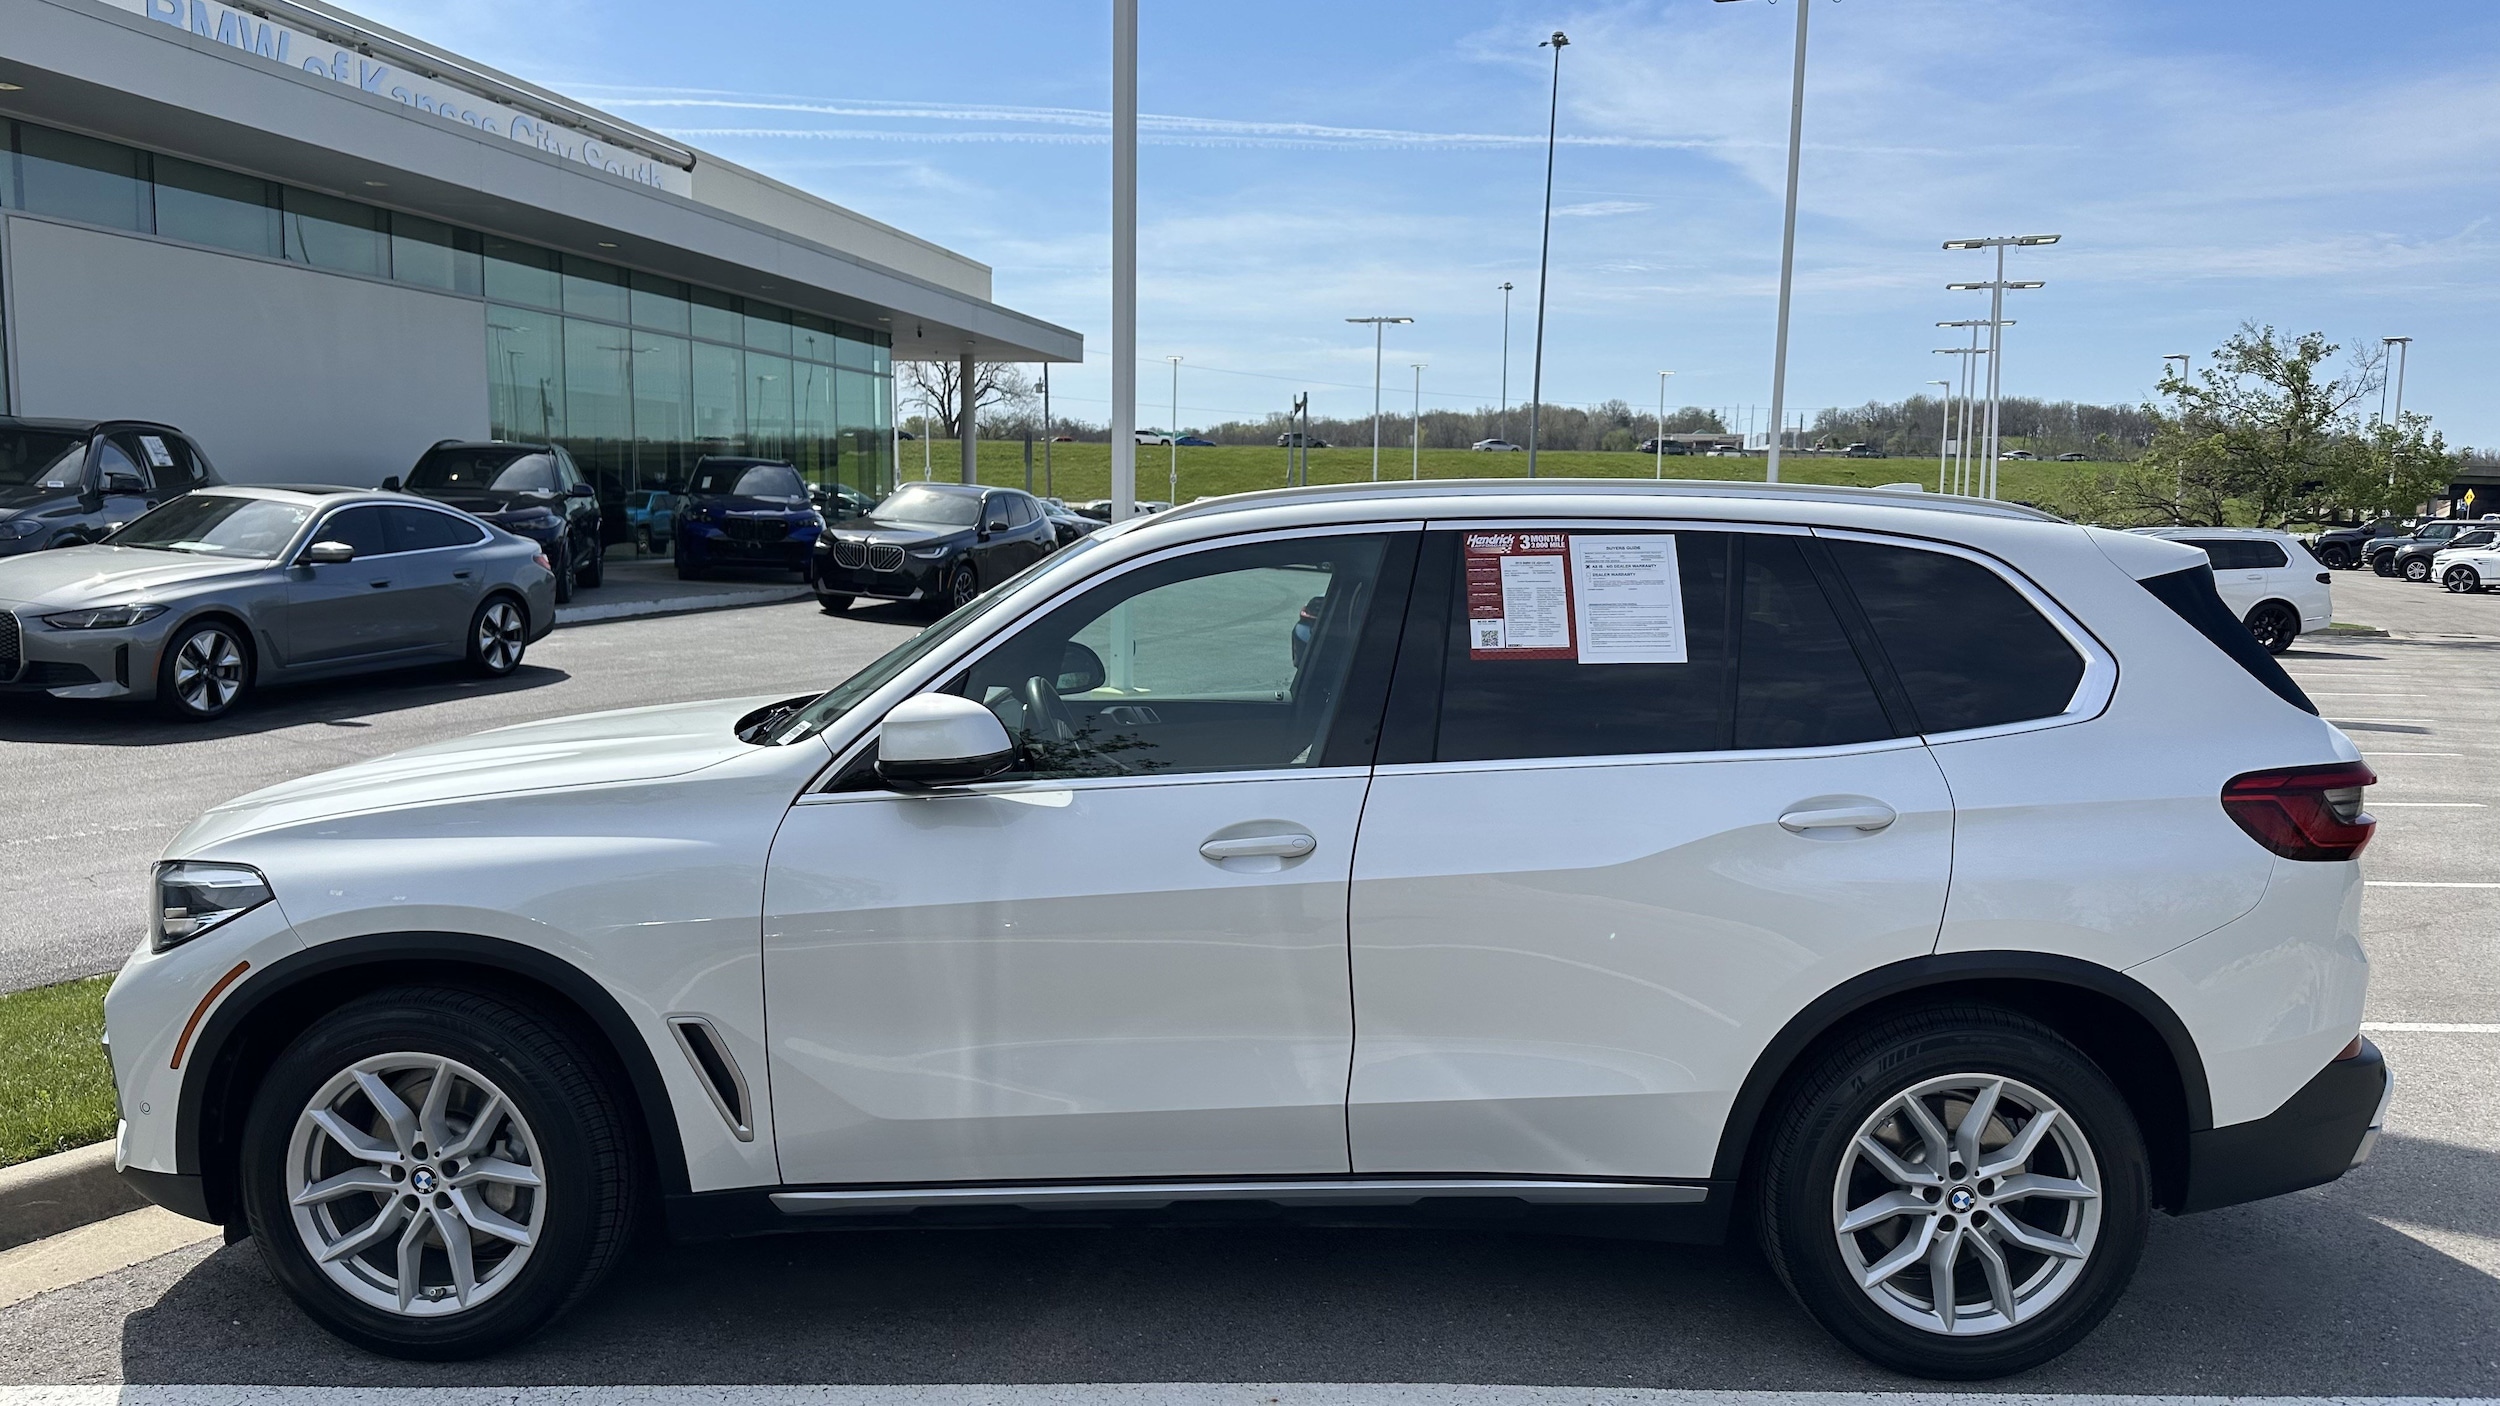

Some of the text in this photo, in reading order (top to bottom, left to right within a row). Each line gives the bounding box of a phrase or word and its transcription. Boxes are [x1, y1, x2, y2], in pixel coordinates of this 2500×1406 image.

[147, 0, 291, 62] BMW
[1466, 534, 1515, 547] Hendrick
[1520, 534, 1531, 549] 3
